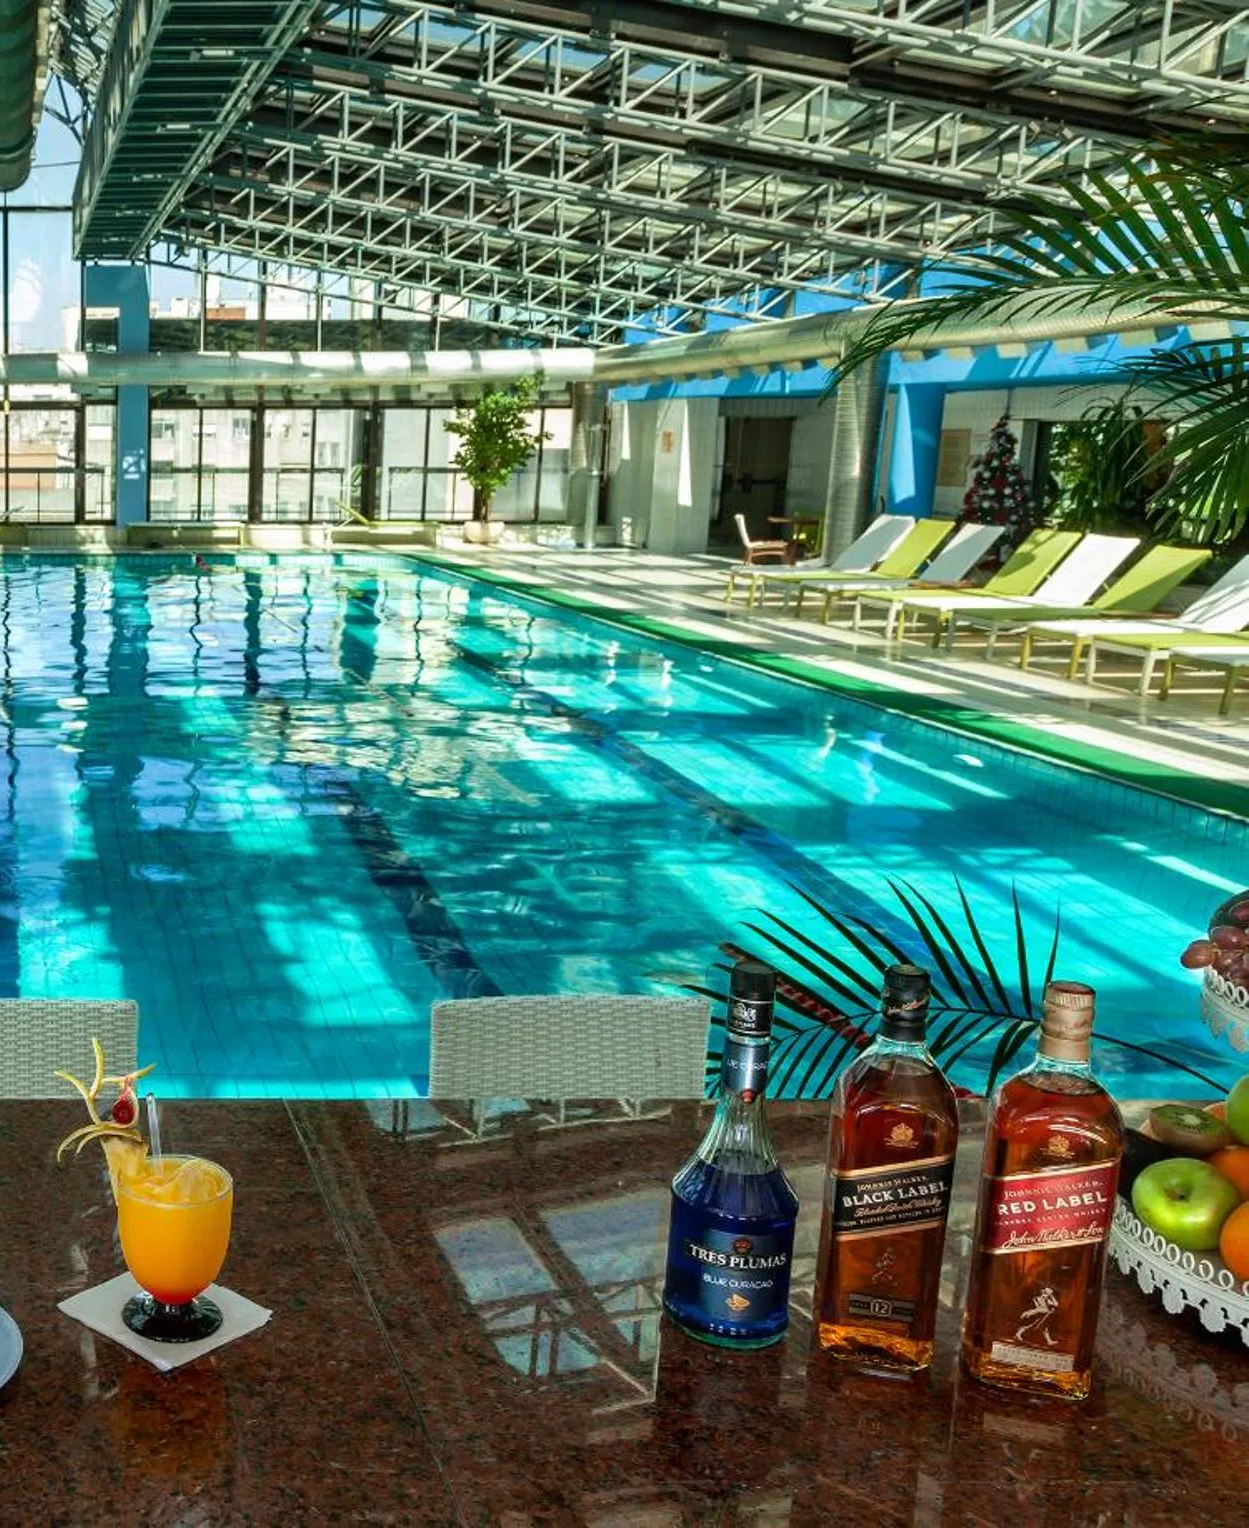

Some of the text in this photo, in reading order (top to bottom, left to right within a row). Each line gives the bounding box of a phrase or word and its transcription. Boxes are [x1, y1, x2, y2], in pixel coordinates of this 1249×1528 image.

[842, 1181, 948, 1207] BLACK LABEL
[1004, 1180, 1100, 1201] JOHNNIE WALKER
[997, 1191, 1107, 1215] RED LABEL
[689, 1244, 787, 1269] TRES PLUMAS
[703, 1272, 728, 1288] BLUE
[874, 1302, 888, 1314] 12
